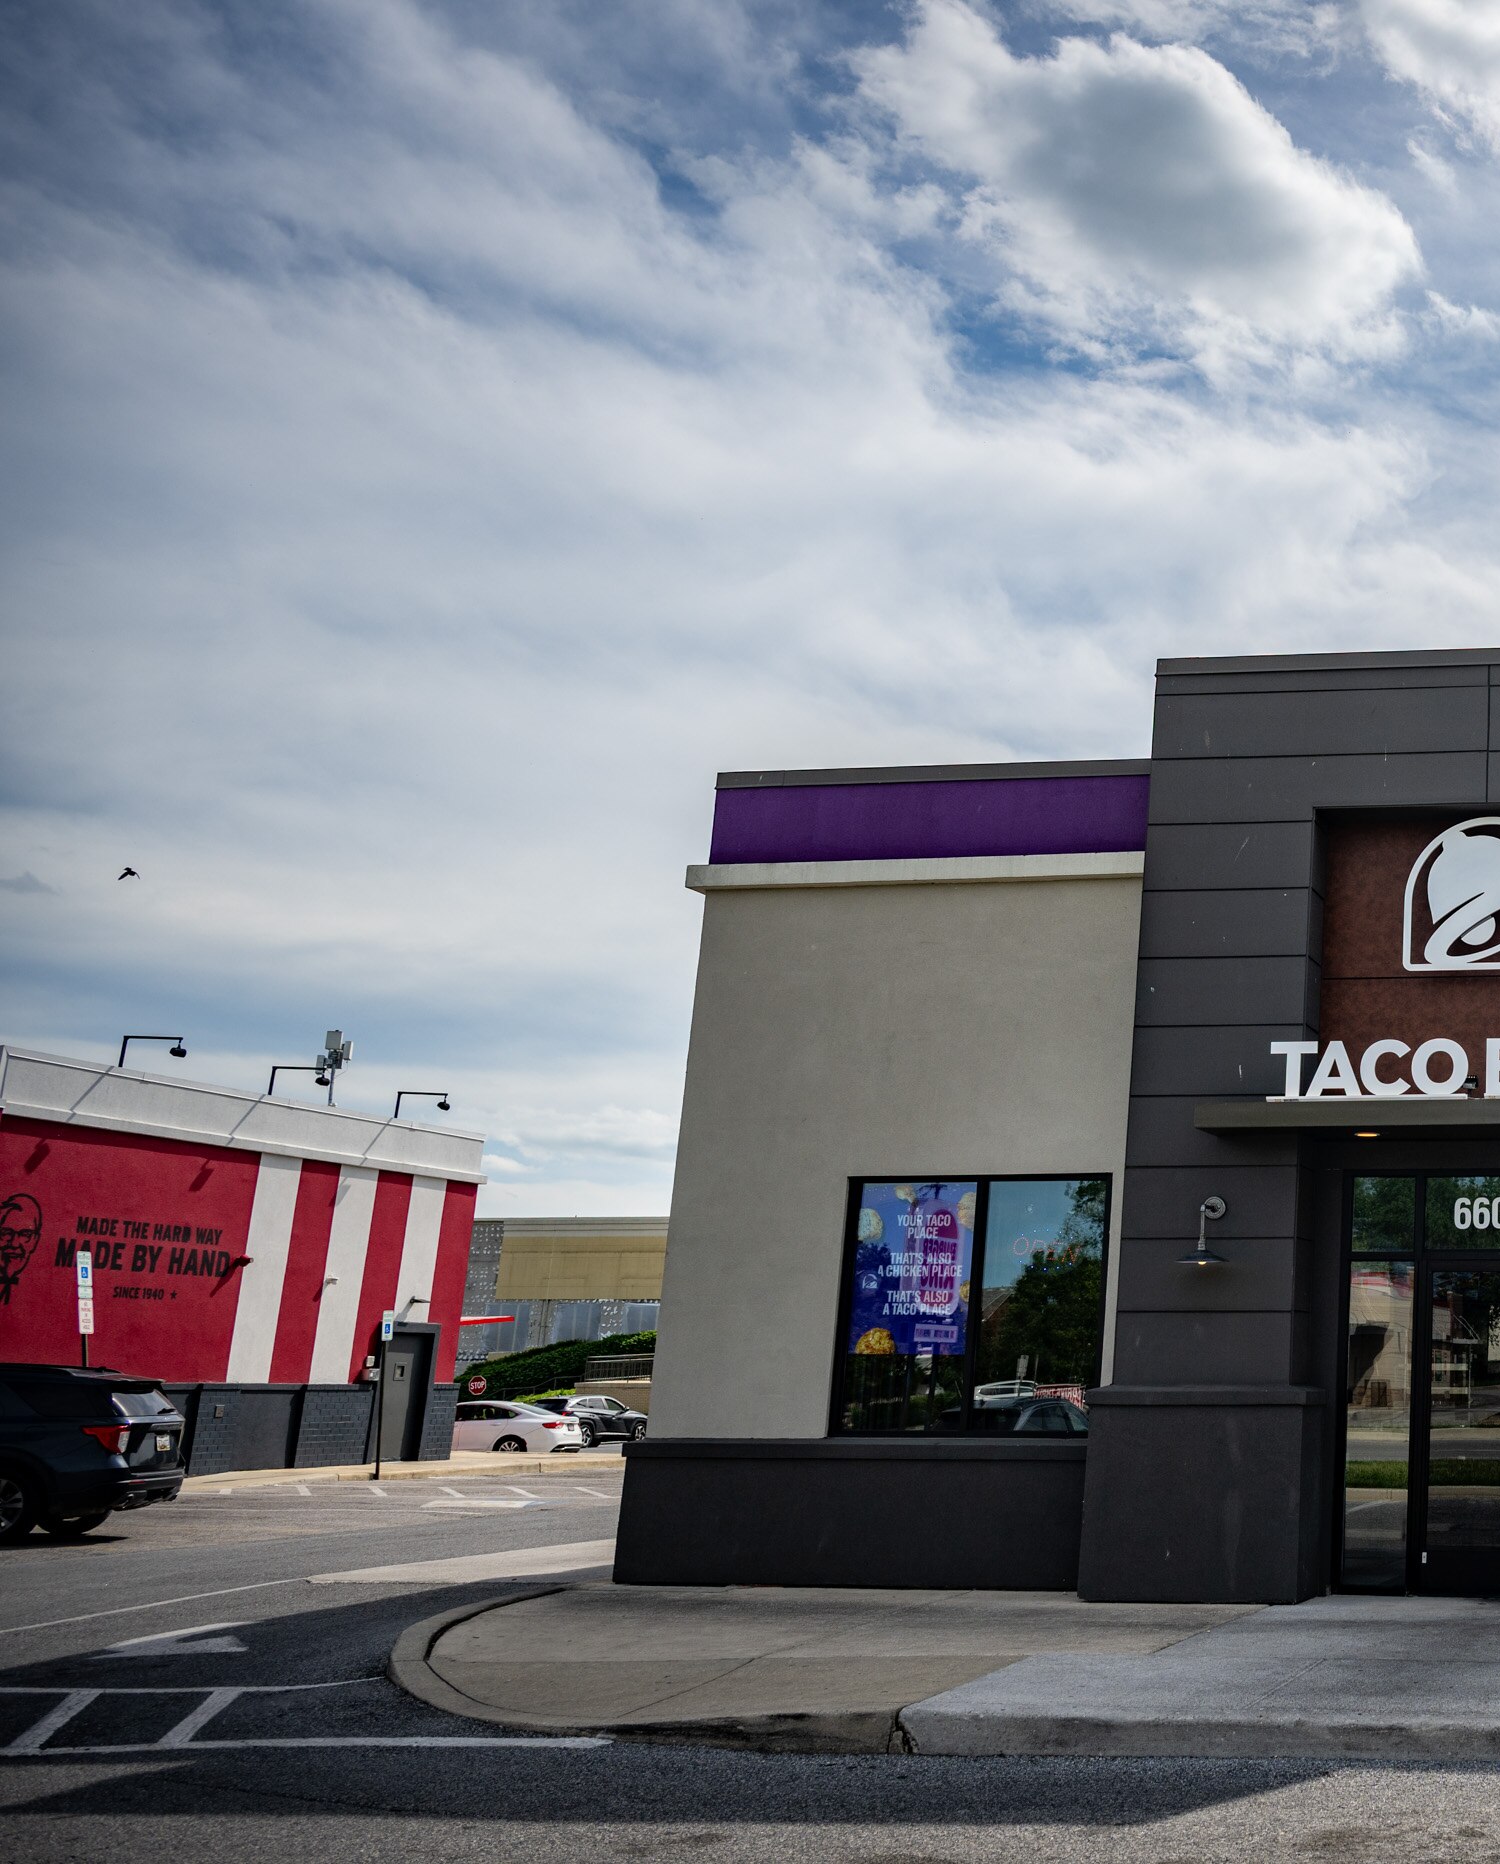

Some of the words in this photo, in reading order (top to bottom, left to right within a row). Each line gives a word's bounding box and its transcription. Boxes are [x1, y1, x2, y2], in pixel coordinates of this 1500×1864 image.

[1270, 1037, 1469, 1097] TACO
[897, 1214, 923, 1227] YOUR
[926, 1214, 951, 1227] TACO
[76, 1216, 119, 1237] MADE
[123, 1220, 148, 1240] THE
[152, 1223, 191, 1243] HARD
[195, 1227, 223, 1246] WAY
[907, 1227, 939, 1239] PLACE
[131, 1244, 164, 1274] BY
[167, 1247, 231, 1278] HAND
[890, 1252, 924, 1265] THAT'S
[927, 1252, 952, 1265] ALSO
[877, 1264, 885, 1277] A
[886, 1264, 929, 1277] CHICKEN
[931, 1264, 963, 1277] PLACE
[113, 1286, 140, 1299] SINCE
[142, 1288, 164, 1300] 1940
[887, 1290, 922, 1303] THAT'S
[923, 1290, 949, 1303] ALSO
[882, 1303, 890, 1316] A
[892, 1303, 917, 1316] TACO
[920, 1303, 951, 1316] PLACE
[470, 1380, 485, 1390] STOP
